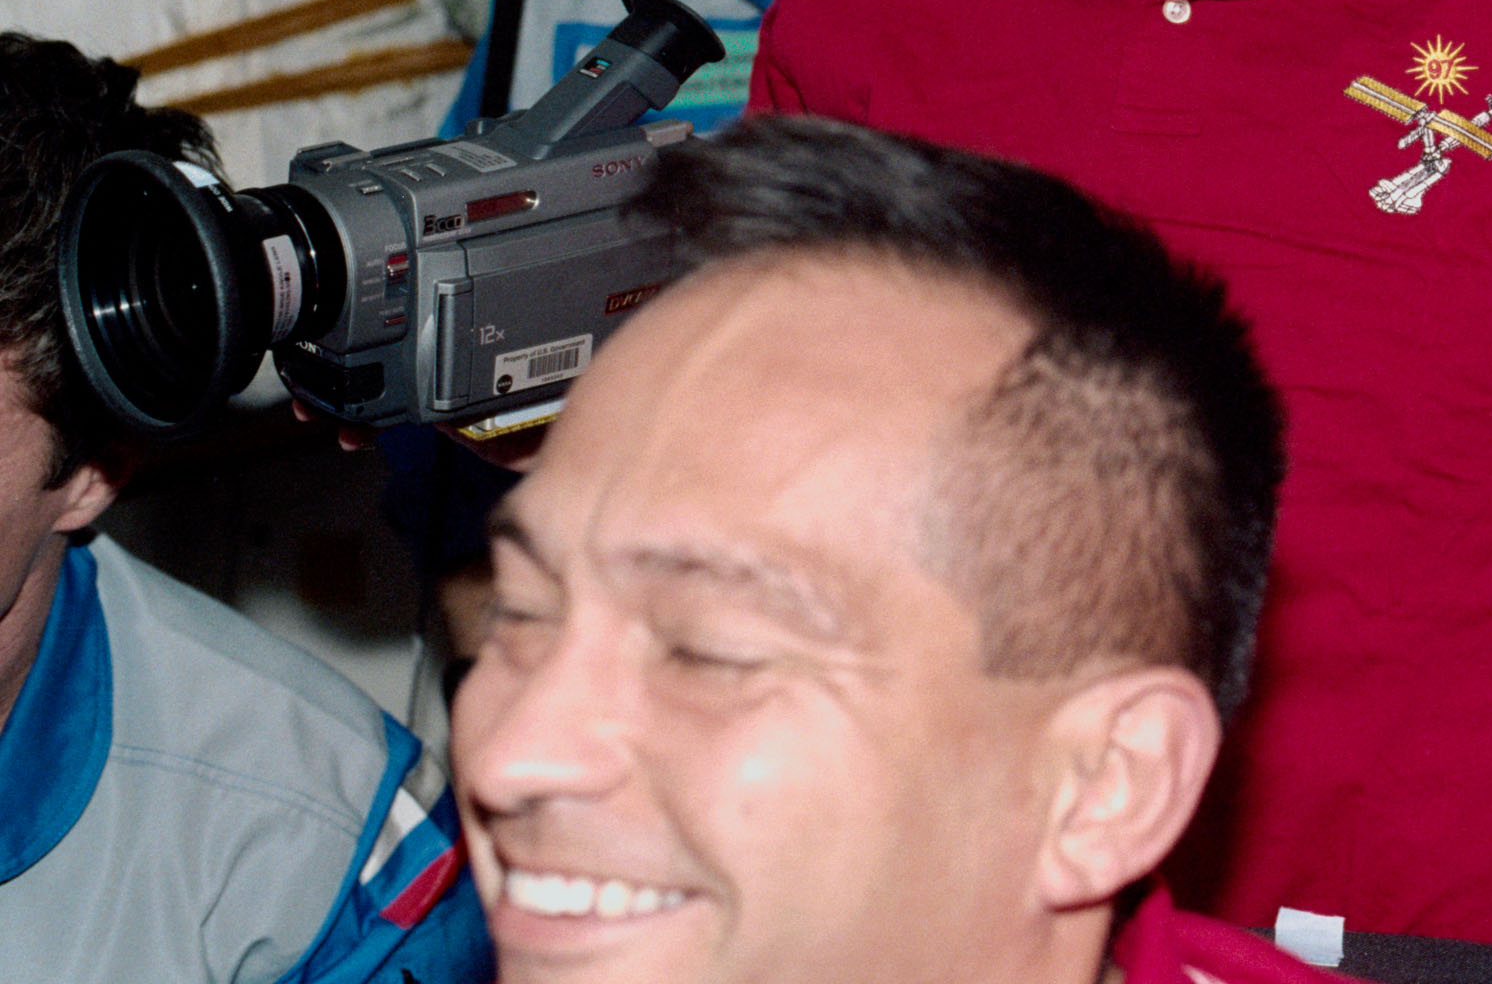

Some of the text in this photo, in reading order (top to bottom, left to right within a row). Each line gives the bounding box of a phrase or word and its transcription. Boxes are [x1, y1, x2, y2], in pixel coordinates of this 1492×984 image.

[1427, 59, 1454, 80] 97
[592, 155, 647, 178] SONY
[480, 324, 505, 345] 12x
[503, 353, 529, 363] Property
[550, 338, 586, 353] Government
